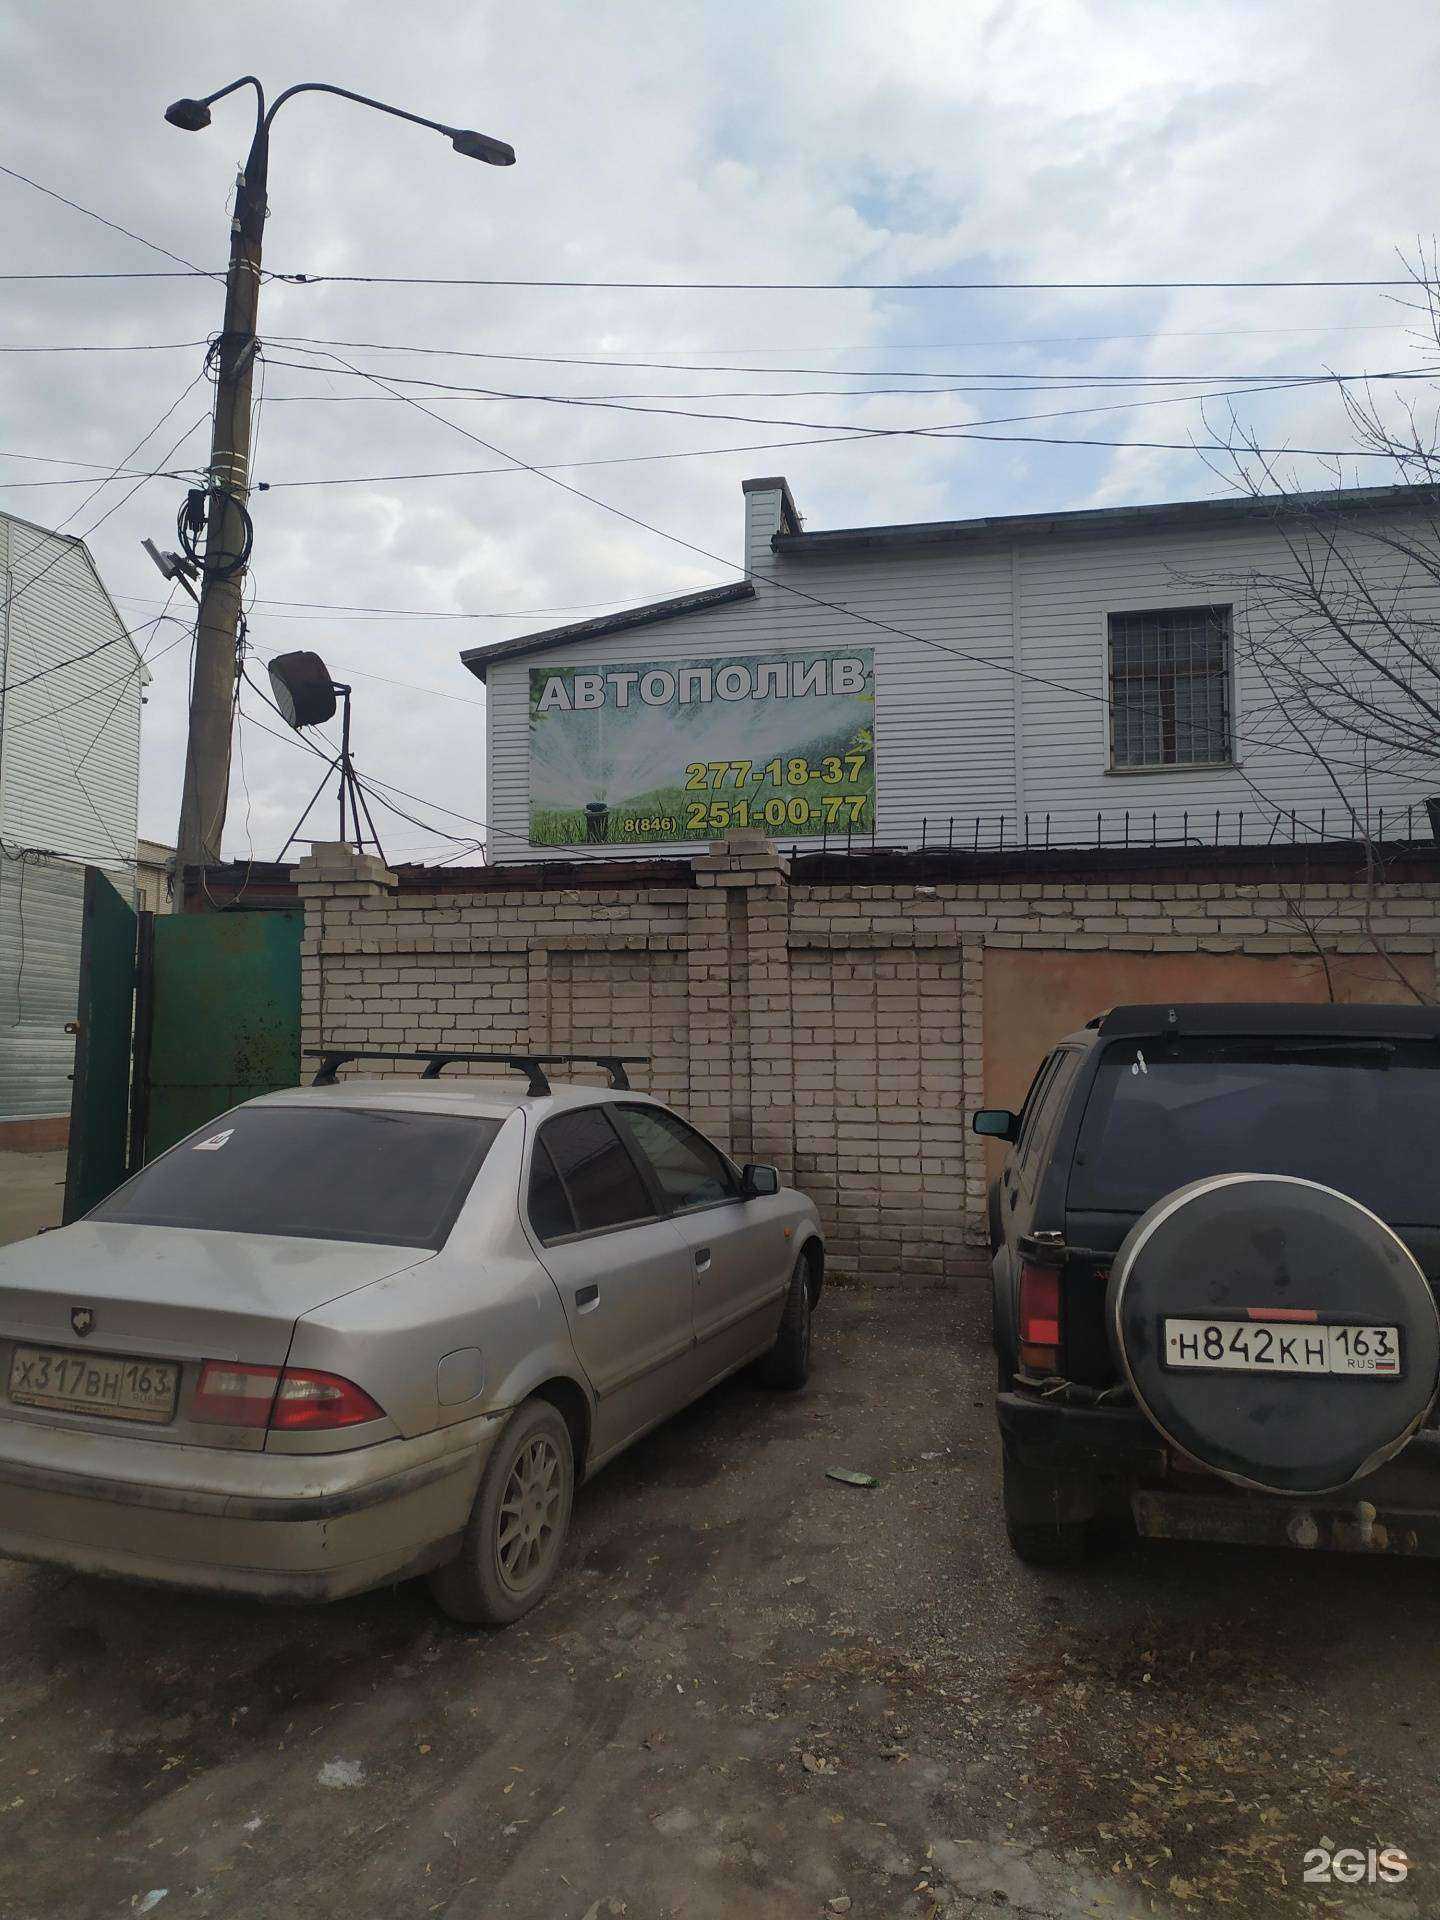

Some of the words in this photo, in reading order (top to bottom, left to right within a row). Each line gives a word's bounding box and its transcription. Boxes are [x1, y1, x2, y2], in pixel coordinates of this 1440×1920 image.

[536, 658, 866, 711] АВТОПОЛИВ
[685, 756, 867, 790] 277-18-37
[624, 816, 677, 834] 8(846)
[686, 796, 867, 830] 251-00-77
[1336, 1329, 1389, 1357] 163
[1347, 1358, 1375, 1370] RUS
[127, 1366, 169, 1394] 163
